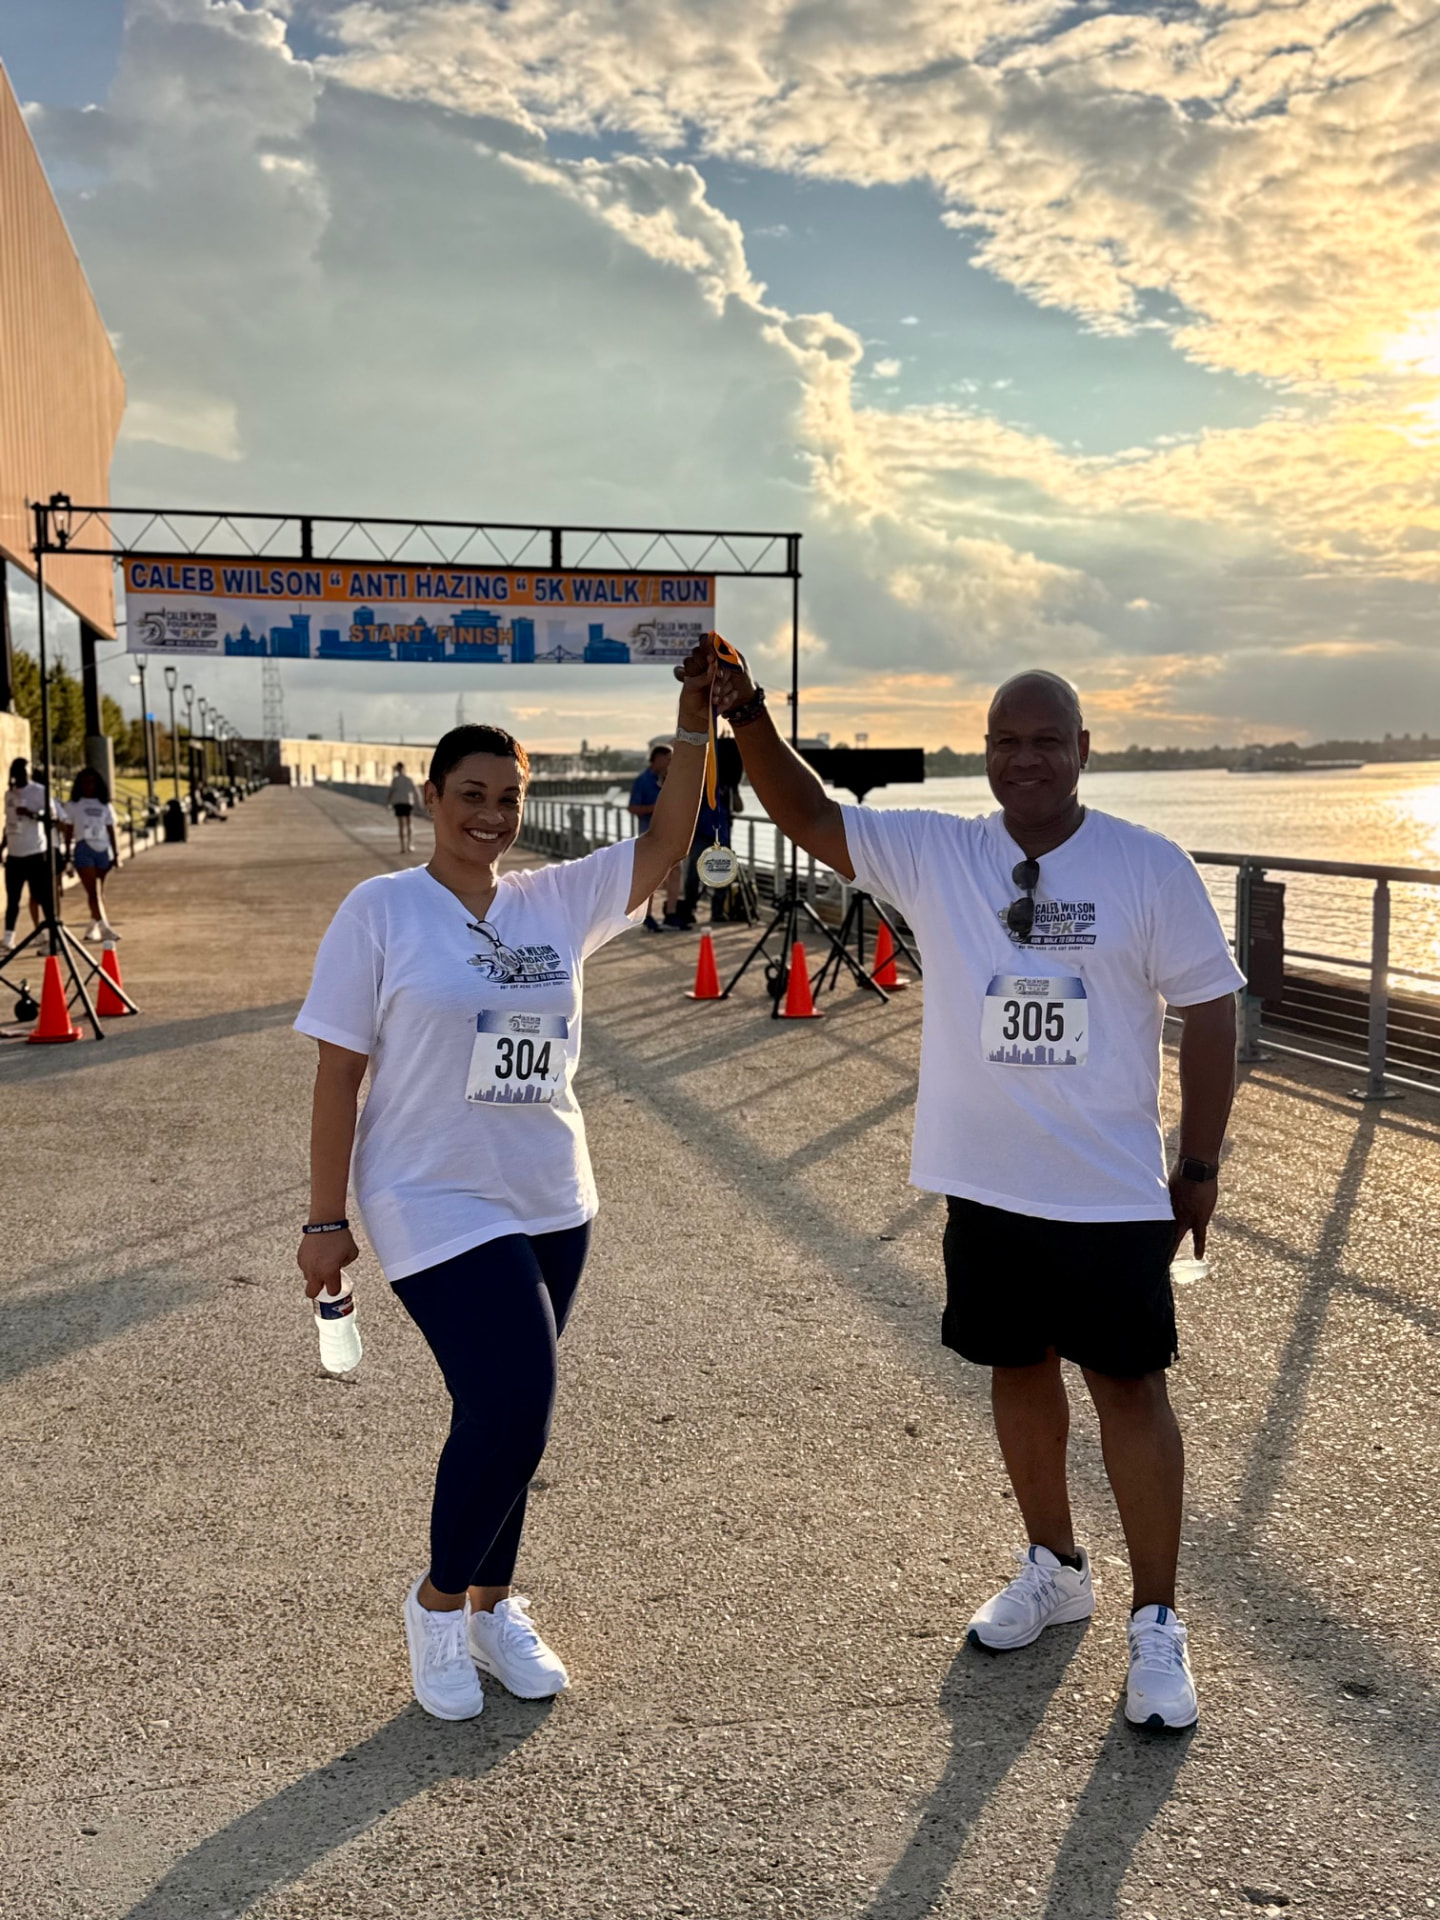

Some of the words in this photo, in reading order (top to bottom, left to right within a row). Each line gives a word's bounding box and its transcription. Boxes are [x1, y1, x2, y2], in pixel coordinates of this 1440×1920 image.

[131, 563, 214, 592] CALEB
[223, 569, 321, 596] WILSON
[350, 572, 406, 597] ANTI
[415, 574, 508, 600] HAZING
[535, 578, 564, 601] 5K
[572, 578, 639, 602] WALK
[661, 579, 708, 602] RUN
[350, 624, 424, 642] START
[437, 626, 514, 645] FINISH
[1035, 902, 1059, 914] CALEB
[1061, 902, 1095, 913] WILSON
[1035, 913, 1095, 923] FOUNDATION
[1051, 921, 1074, 934] 5K
[524, 945, 555, 957] WILSON
[526, 963, 549, 974] 5K
[1003, 1000, 1064, 1042] 305
[495, 1037, 551, 1081] 304
